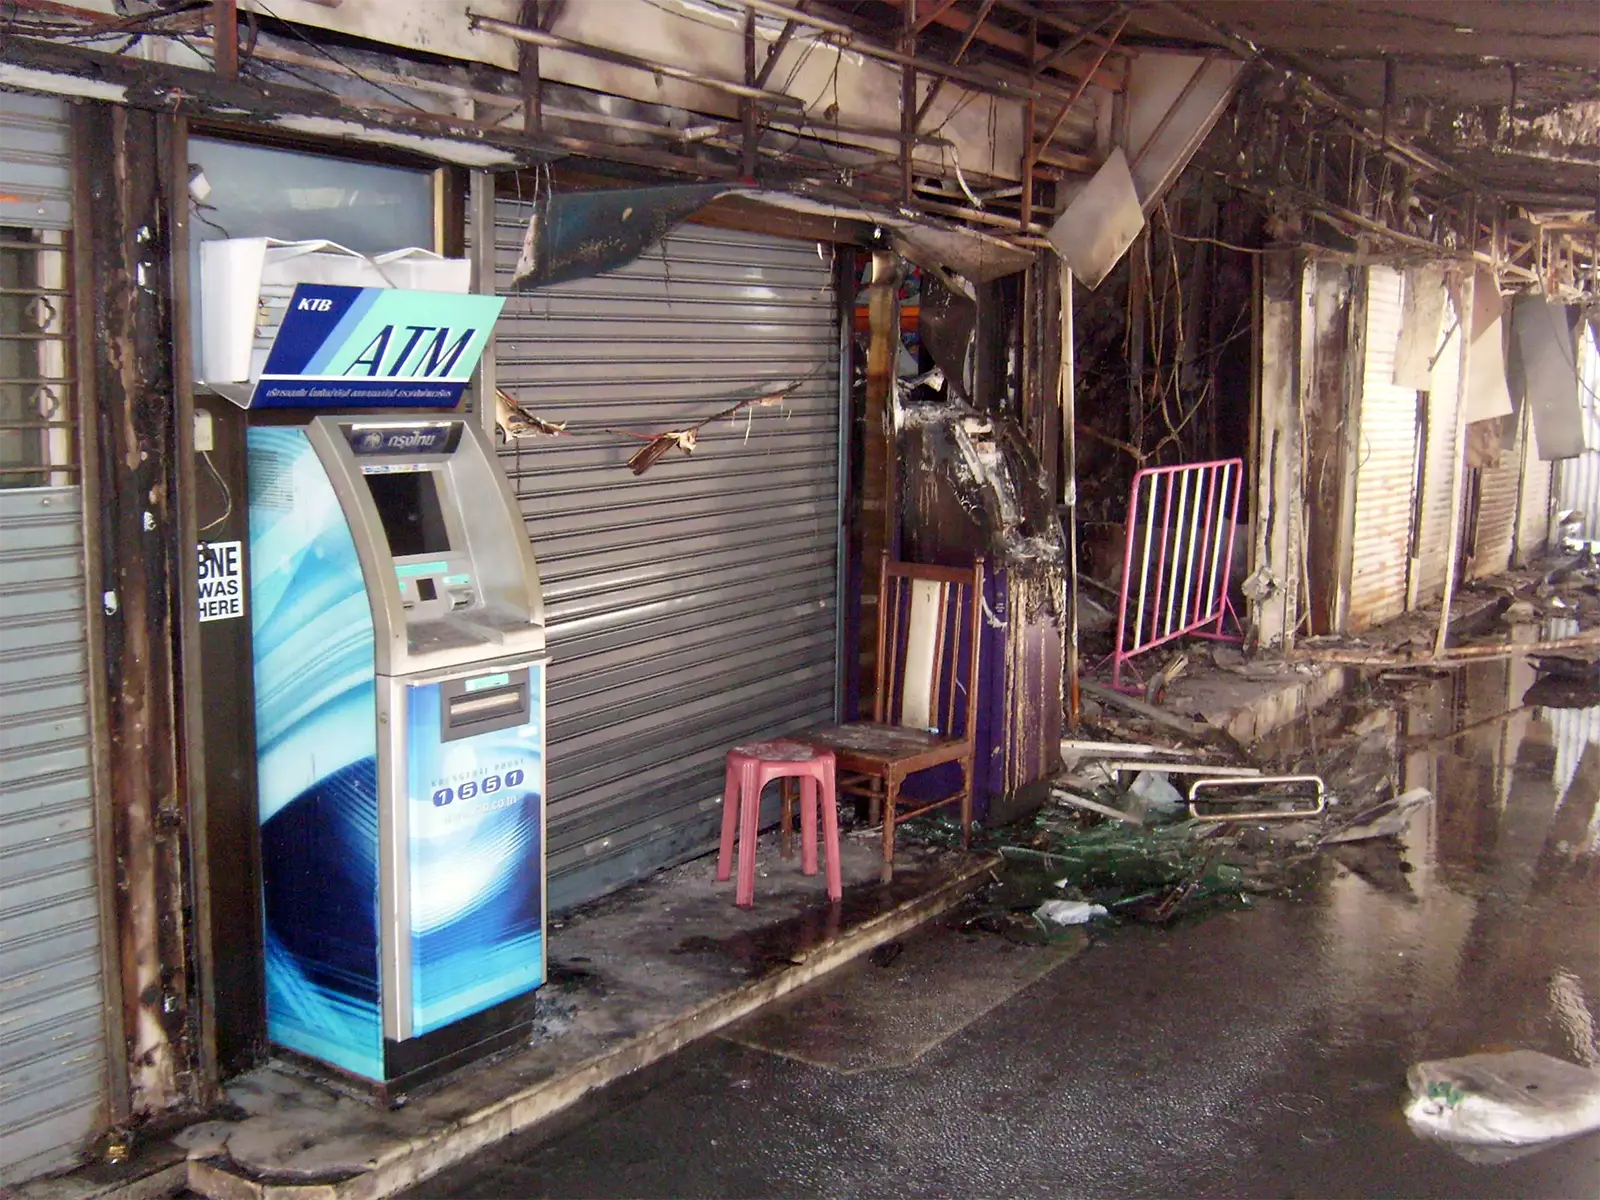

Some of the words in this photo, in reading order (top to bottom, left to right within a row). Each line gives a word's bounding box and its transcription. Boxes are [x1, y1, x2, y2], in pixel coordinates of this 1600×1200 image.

[298, 298, 333, 312] KTB
[343, 324, 478, 377] ATM
[388, 431, 436, 449] กรุงไทย
[197, 546, 238, 579] BNE
[198, 580, 238, 598] WAS
[198, 599, 239, 617] HERE
[434, 770, 523, 806] 1551
